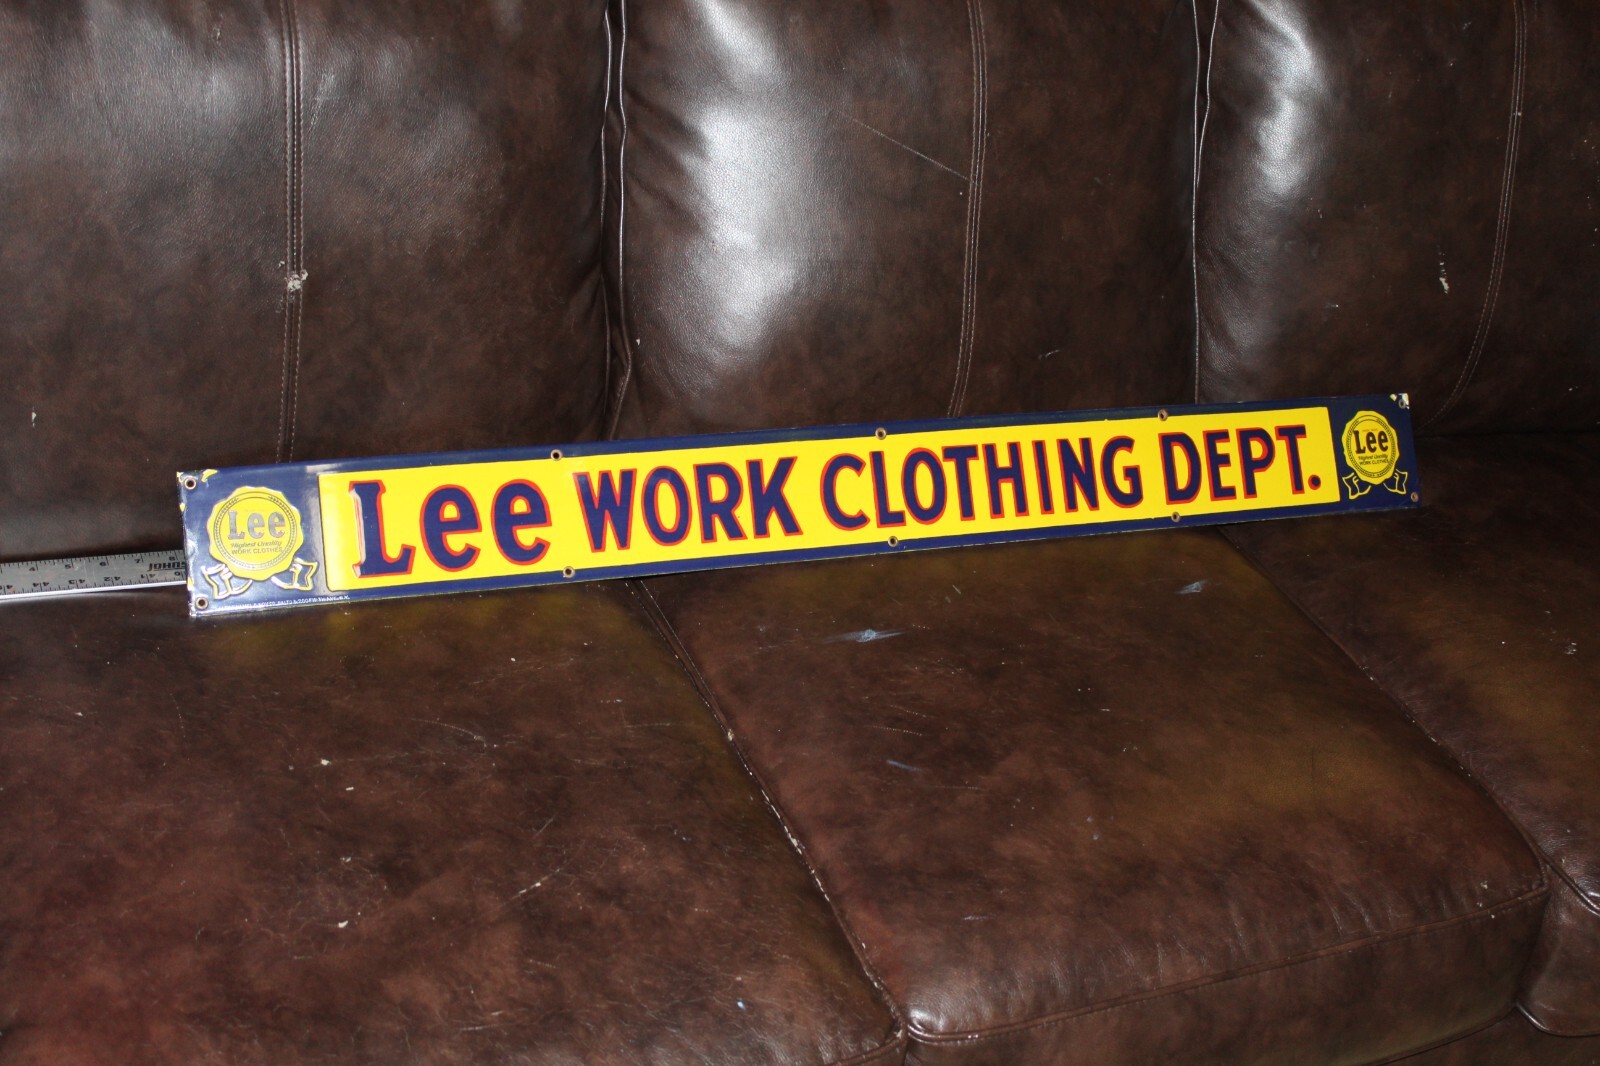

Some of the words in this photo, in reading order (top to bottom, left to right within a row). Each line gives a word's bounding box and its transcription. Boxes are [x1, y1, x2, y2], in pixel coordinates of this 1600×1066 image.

[1353, 430, 1388, 454] Lee
[349, 478, 553, 578] Lee
[573, 456, 804, 553] WORK
[819, 435, 1144, 532] CLOTHING
[1158, 425, 1323, 504] DEPT.
[228, 510, 286, 540] Lee
